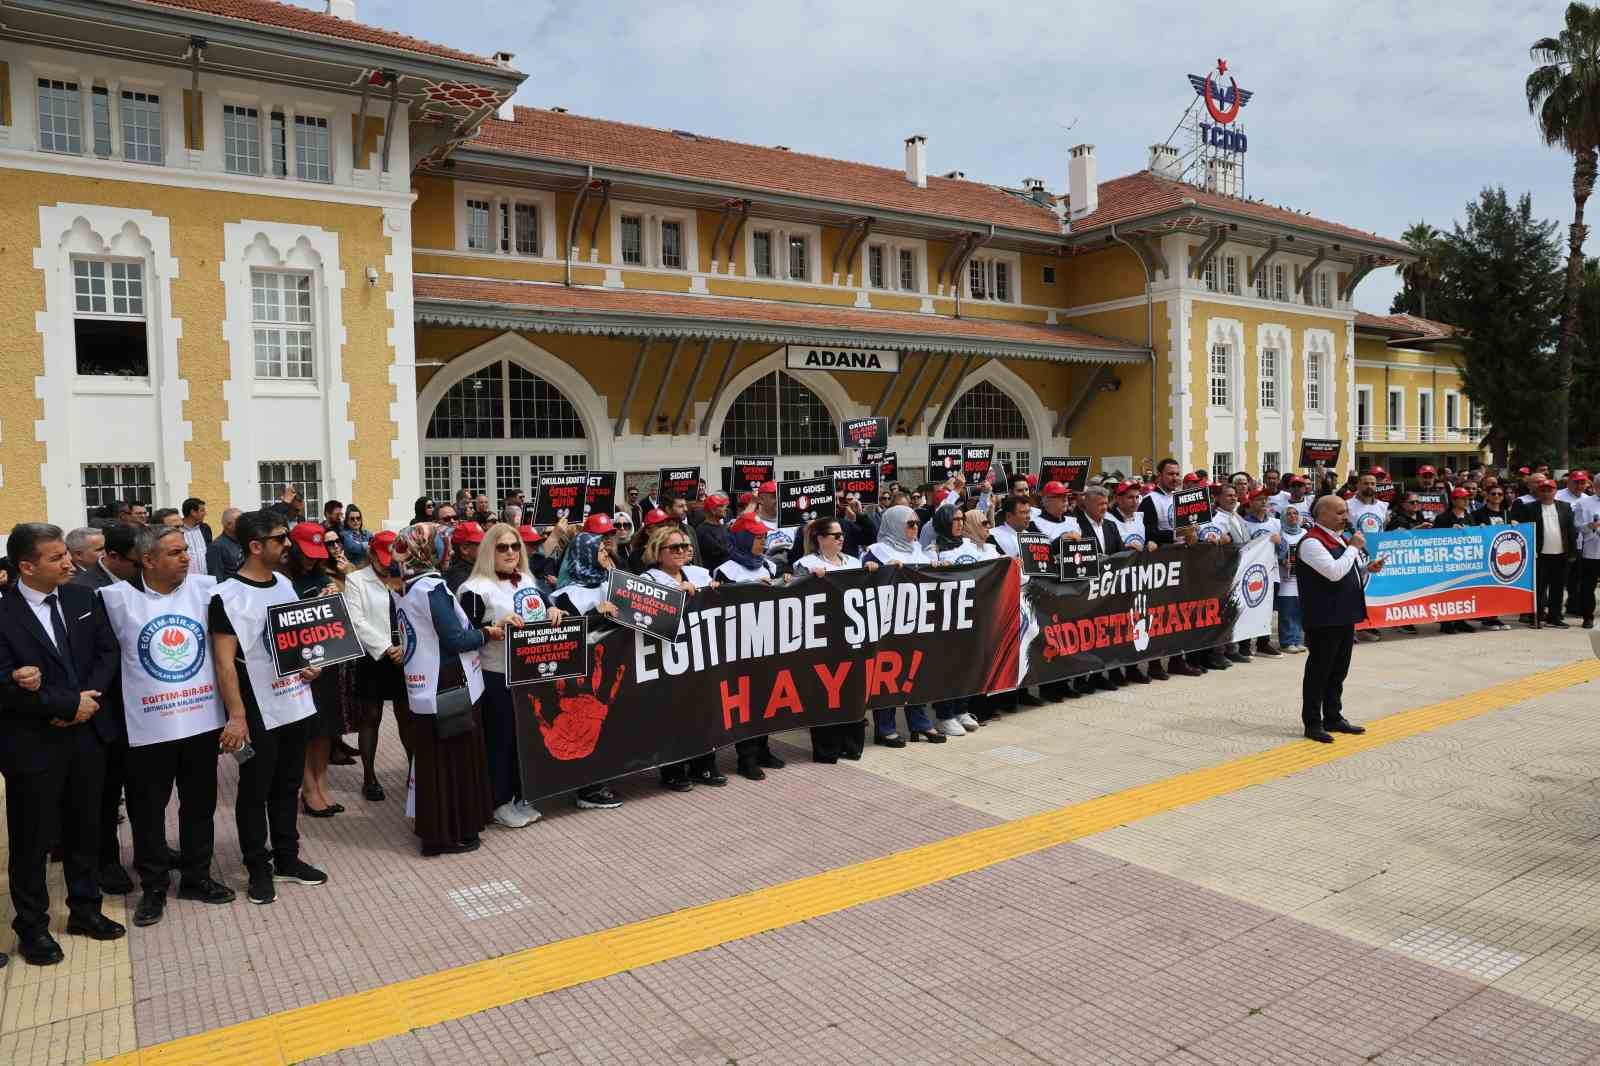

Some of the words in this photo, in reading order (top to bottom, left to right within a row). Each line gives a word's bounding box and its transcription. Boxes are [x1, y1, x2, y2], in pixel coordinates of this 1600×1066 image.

[805, 350, 882, 369] ADANA
[848, 419, 877, 430] OKULDA
[967, 449, 989, 459] NEREYE
[541, 477, 565, 485] OKULDA
[833, 469, 871, 480] NEREYE
[790, 487, 801, 495] BU
[802, 483, 826, 493] GİDİŞE
[847, 480, 875, 492] GİDİŞ
[781, 501, 796, 509] DUR
[810, 495, 833, 505] DİYELİM
[1179, 491, 1204, 504] NEREYE
[1177, 504, 1189, 517] BU
[1412, 536, 1482, 548] KONFEDERASYONU
[1087, 561, 1182, 601] EĞİTİMDE
[616, 588, 630, 598] ACI
[631, 592, 641, 602] VE
[625, 579, 668, 601] ŞİDDET
[278, 604, 333, 627] NEREYE
[630, 601, 658, 616] DEMEK
[843, 579, 976, 649] ŞİDDETE
[1385, 606, 1428, 622] ADANA
[1429, 595, 1477, 621] ŞUBESİ
[1147, 598, 1222, 638] HAYIR
[276, 631, 298, 650] BU
[299, 622, 345, 646] GİDİŞ
[513, 630, 536, 639] EĞİTİM
[536, 625, 581, 636] KURUMLARINI
[527, 635, 549, 645] HEDEF
[549, 633, 567, 642] ALAN
[525, 651, 570, 665] AYAKTAYIZ
